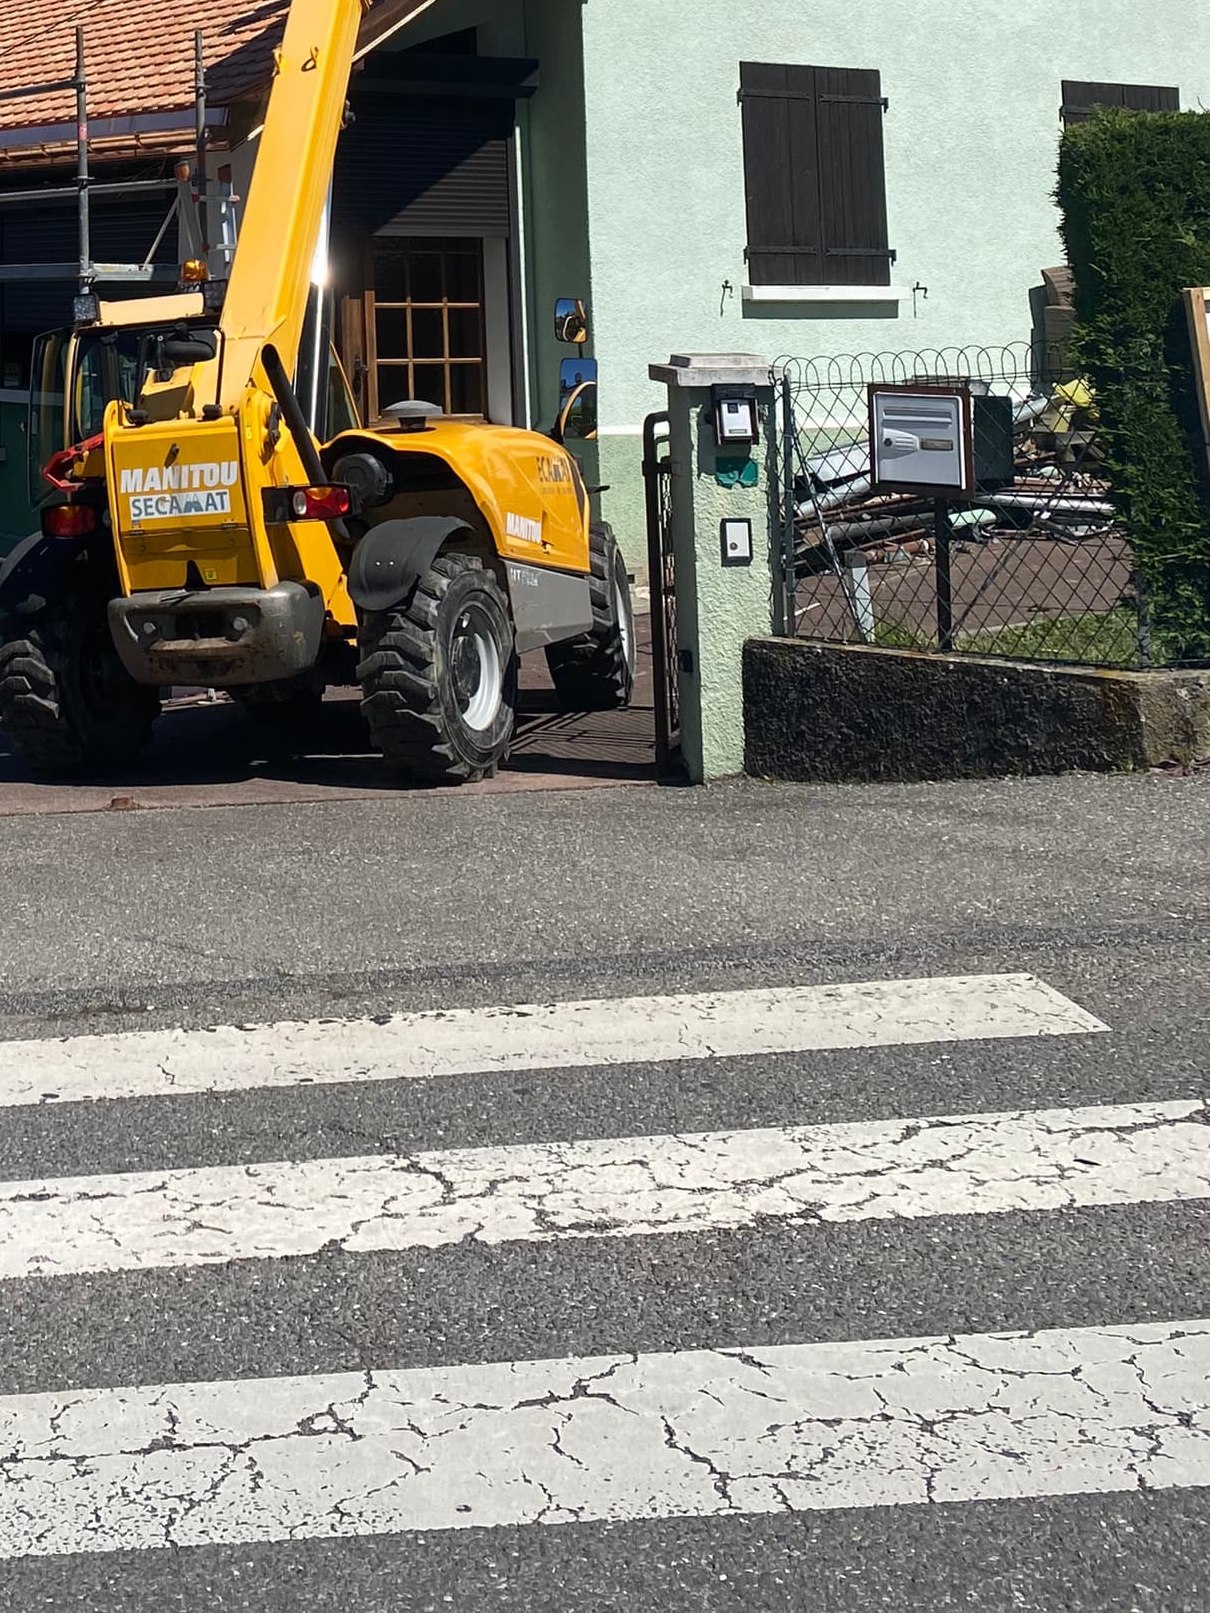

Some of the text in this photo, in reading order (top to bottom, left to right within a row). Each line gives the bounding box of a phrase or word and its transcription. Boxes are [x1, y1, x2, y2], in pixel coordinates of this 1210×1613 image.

[120, 460, 238, 494] MANITOU
[131, 490, 228, 518] SECAMAT
[506, 511, 542, 545] MANITOU
